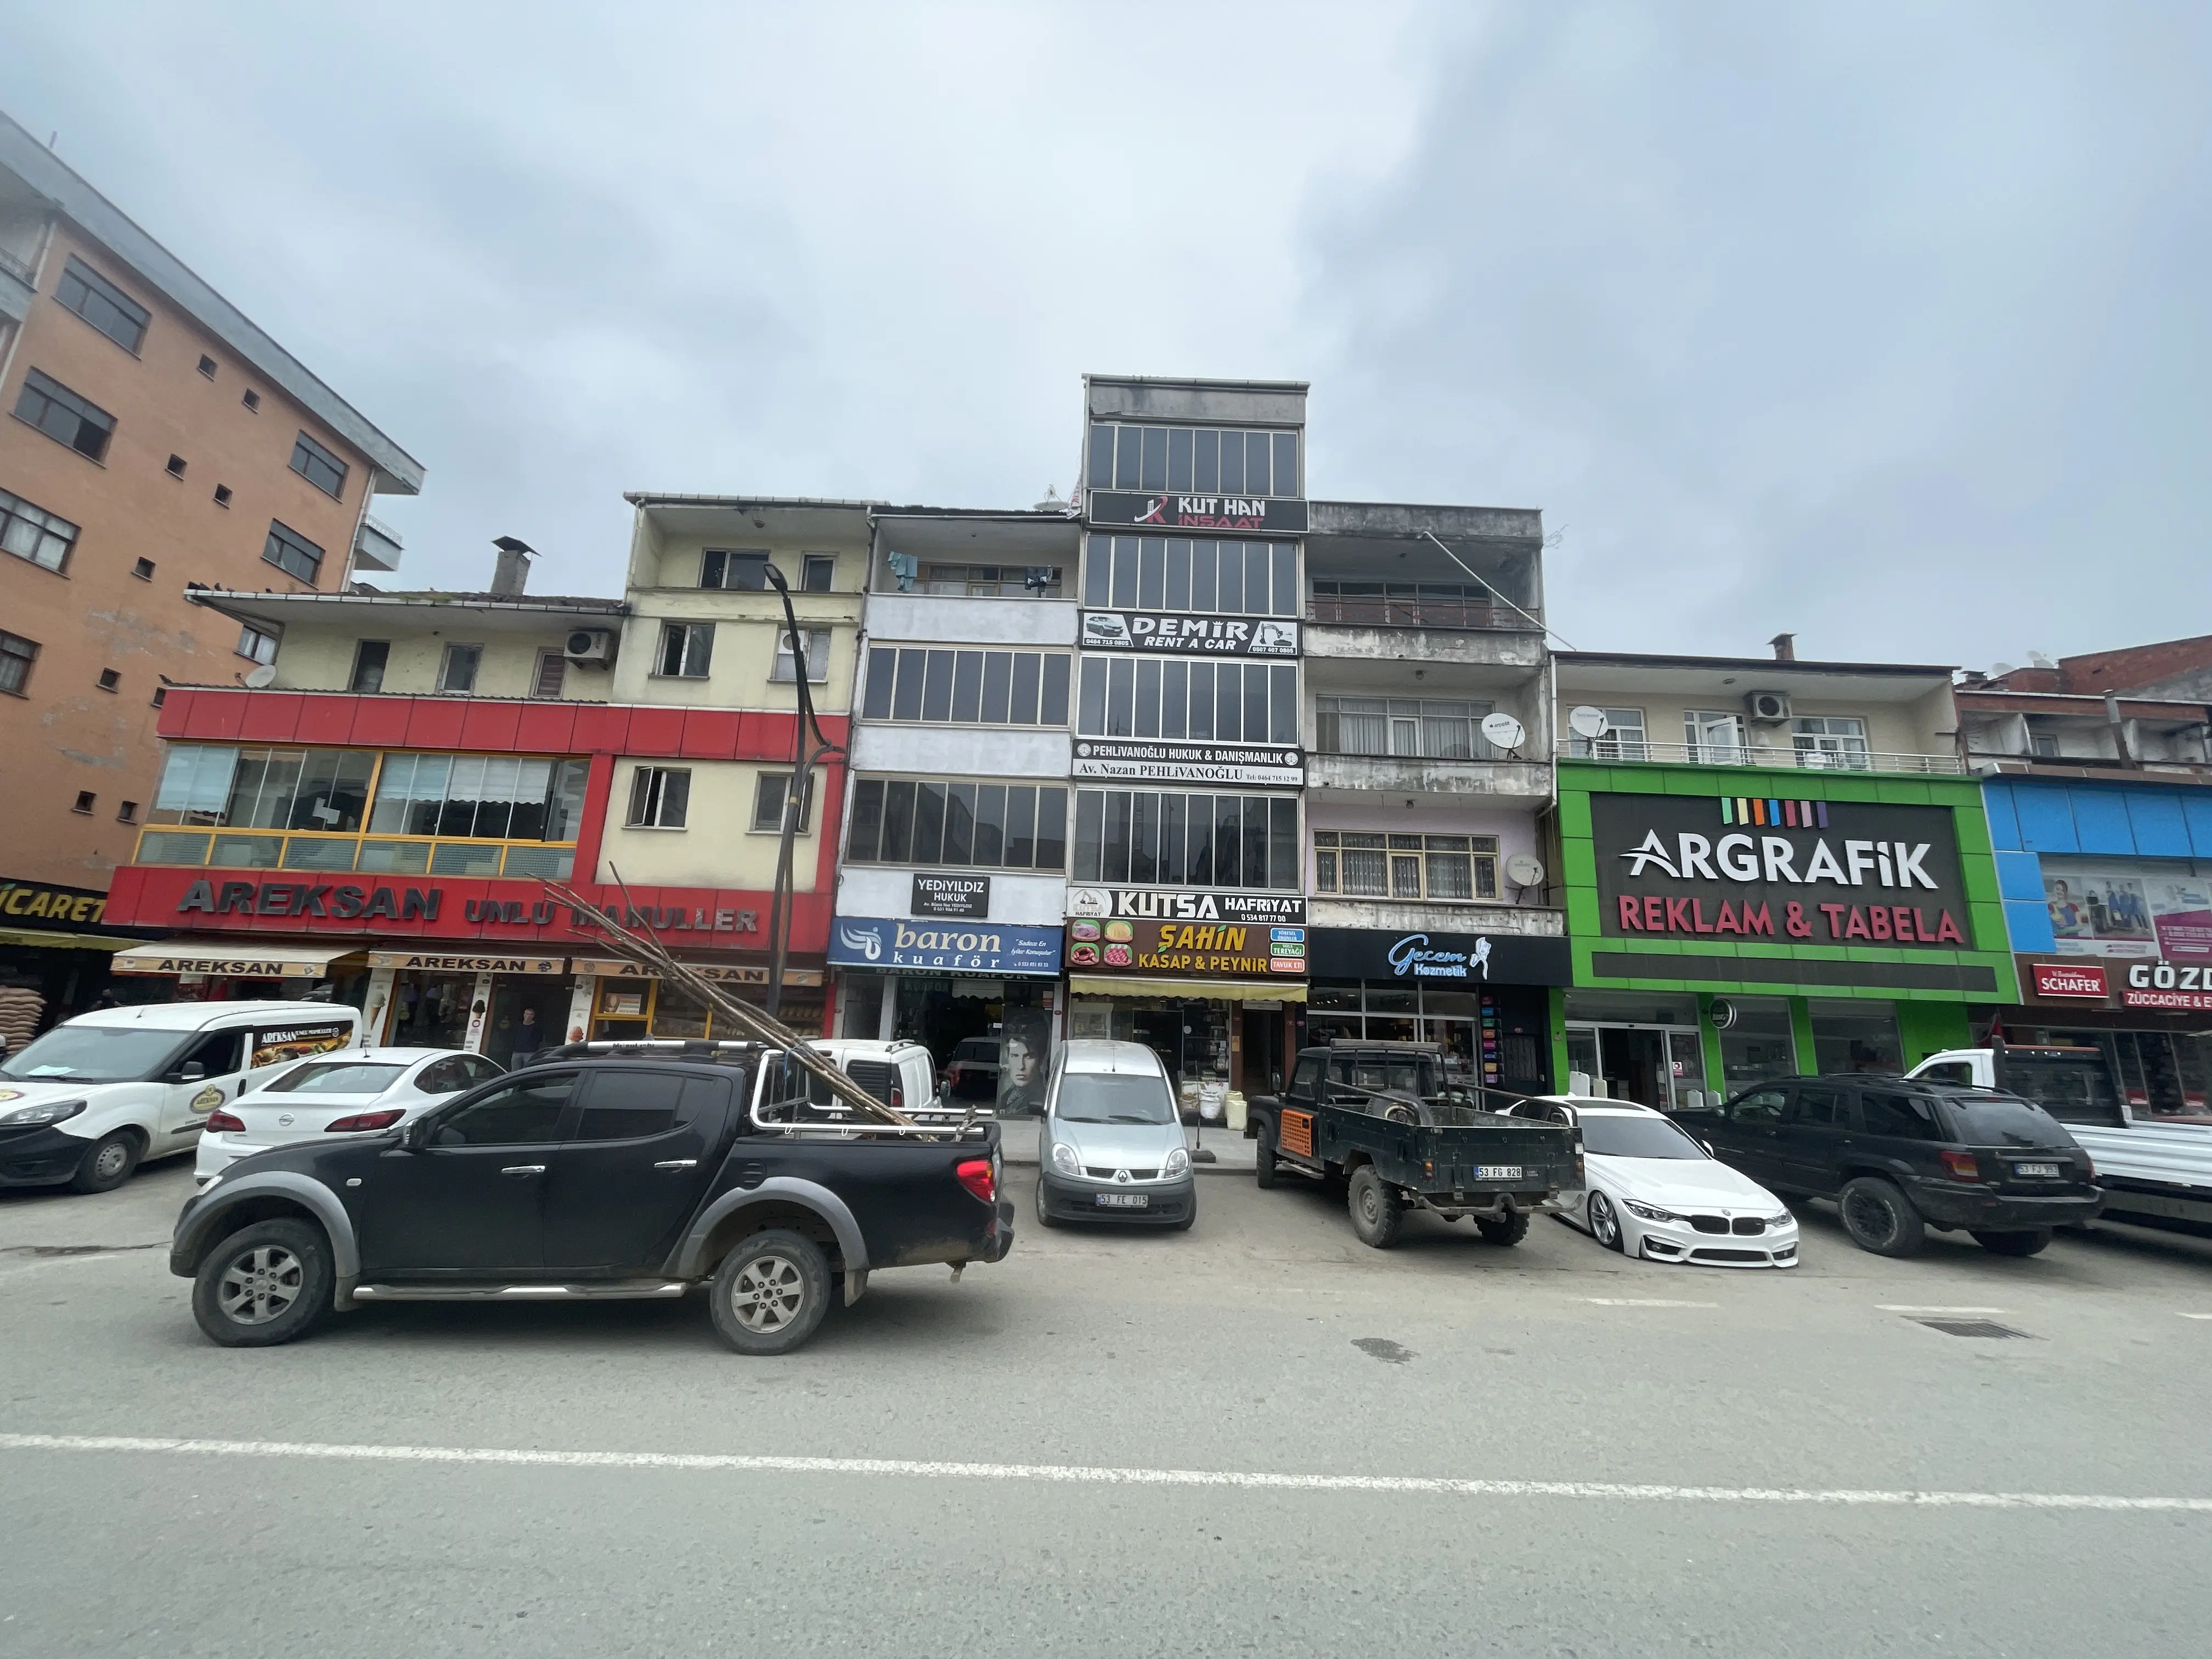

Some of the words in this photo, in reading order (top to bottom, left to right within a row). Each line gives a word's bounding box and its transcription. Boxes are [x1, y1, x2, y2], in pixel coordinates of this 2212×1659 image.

[1178, 497, 1218, 514] KUT
[1224, 499, 1265, 516] HAN
[1144, 636, 1184, 647] RENT
[1188, 638, 1198, 648] A
[1205, 639, 1237, 650] CAR
[1169, 748, 1202, 760] HUKUK
[1204, 749, 1212, 760] &
[1215, 750, 1283, 764] DANIŞMANLIK
[1079, 763, 1096, 774] Av.
[1101, 764, 1136, 775] Nazan
[934, 893, 967, 902] HUKUK
[1118, 891, 1220, 919] KUTSA
[176, 879, 442, 921] AREKSAN
[465, 899, 556, 925] UNLU
[571, 902, 758, 932] MAMULLER
[1618, 895, 1775, 936] REKLAM
[1785, 901, 1812, 938] &
[1820, 902, 1965, 944] TABELA
[894, 923, 1001, 952] baron
[1138, 953, 1190, 969] KASAP
[1195, 955, 1205, 970] &
[1388, 934, 1466, 975] Gecem
[158, 960, 284, 974] AREKSAN
[405, 957, 526, 971] AREKSAN
[1414, 963, 1468, 977] Kozmetik
[619, 964, 763, 981] ARSAN
[2041, 977, 2101, 992] SCHAFER
[2193, 996, 2202, 1007] &
[1479, 1168, 1489, 1177] 53
[1493, 1168, 1503, 1177] FG
[1506, 1168, 1521, 1177] 828
[1101, 1195, 1110, 1203] 53
[1117, 1195, 1126, 1204] FE
[1132, 1196, 1147, 1204] 015
